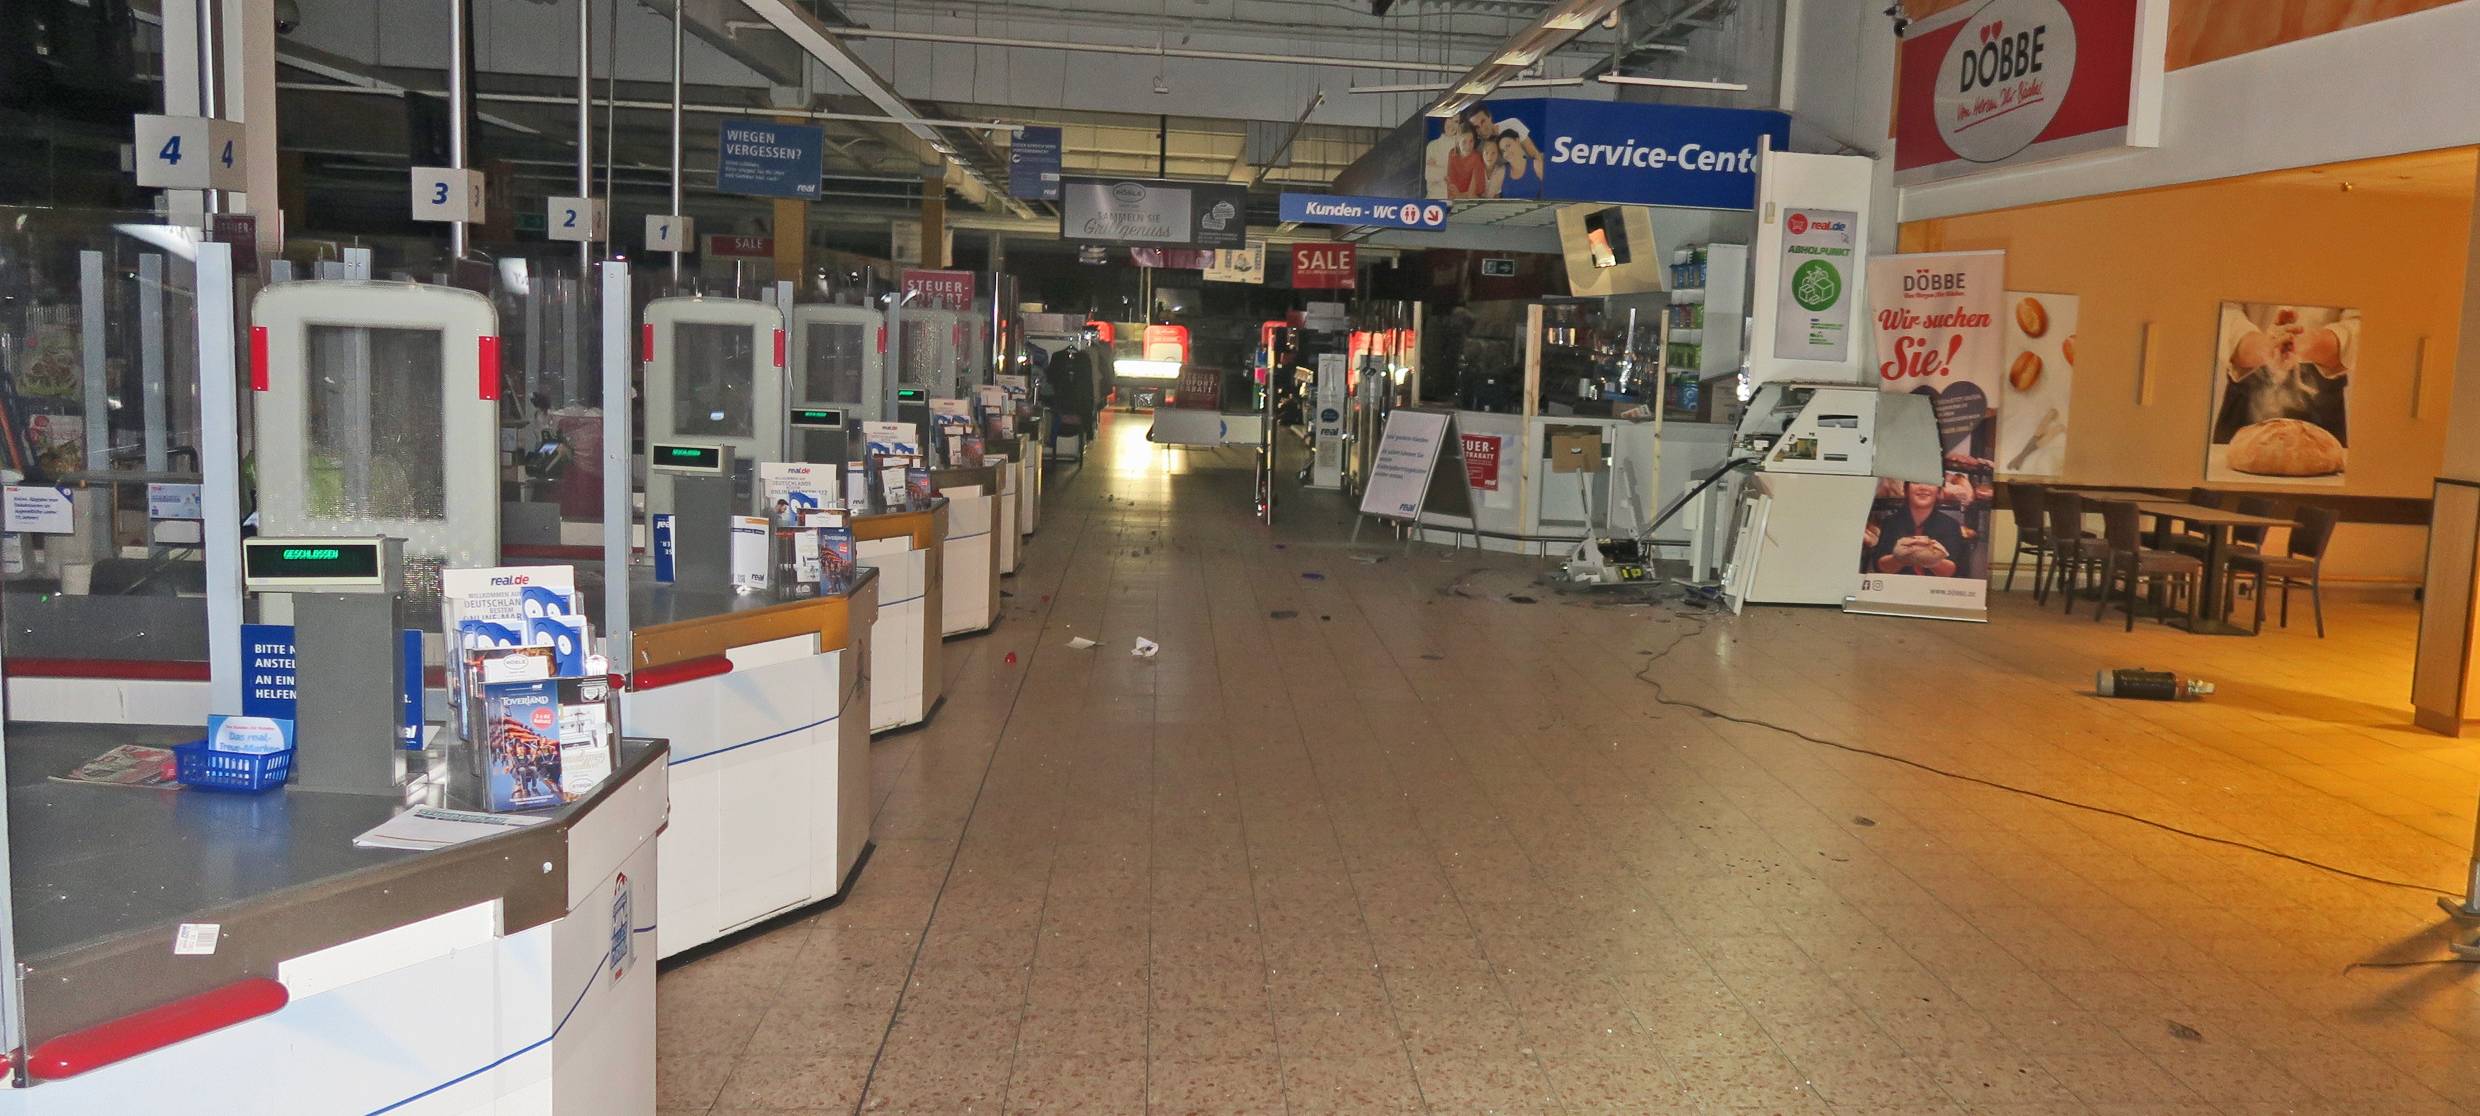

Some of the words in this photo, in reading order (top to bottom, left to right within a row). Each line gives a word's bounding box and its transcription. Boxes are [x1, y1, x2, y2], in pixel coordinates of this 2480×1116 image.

[1960, 20, 2046, 93] DÖBBE
[726, 129, 776, 143] WIEGEN
[159, 136, 182, 165] 4
[221, 140, 234, 168] 4
[726, 143, 802, 159] VERGESSEN?
[431, 182, 449, 205] 3
[796, 184, 816, 192] real
[1305, 201, 1361, 217] Kunden
[1373, 206, 1398, 220] WC
[563, 209, 577, 228] 2
[659, 224, 668, 240] 1
[1811, 221, 1846, 232] real.de
[735, 239, 763, 249] SALE
[1788, 245, 1852, 256] ABHOLPUNKT
[1297, 250, 1350, 270] SALE
[907, 279, 969, 293] STEUER-
[1903, 269, 1966, 292] DÖBBE
[1878, 308, 1920, 331] Wir
[1923, 306, 1992, 329] suchen
[1880, 334, 1963, 381] Sie!
[1320, 427, 1339, 436] real
[1399, 503, 1416, 512] real
[283, 549, 339, 559] GESCHLOSSEN
[490, 575, 529, 586] real.de
[751, 573, 765, 581] real
[464, 599, 522, 609] DEUTSCHLAN
[254, 644, 286, 654] BITTE
[255, 675, 272, 685] AN
[276, 676, 295, 686] EIN
[255, 690, 297, 700] HELFEN
[500, 695, 549, 706] TOVERLAND
